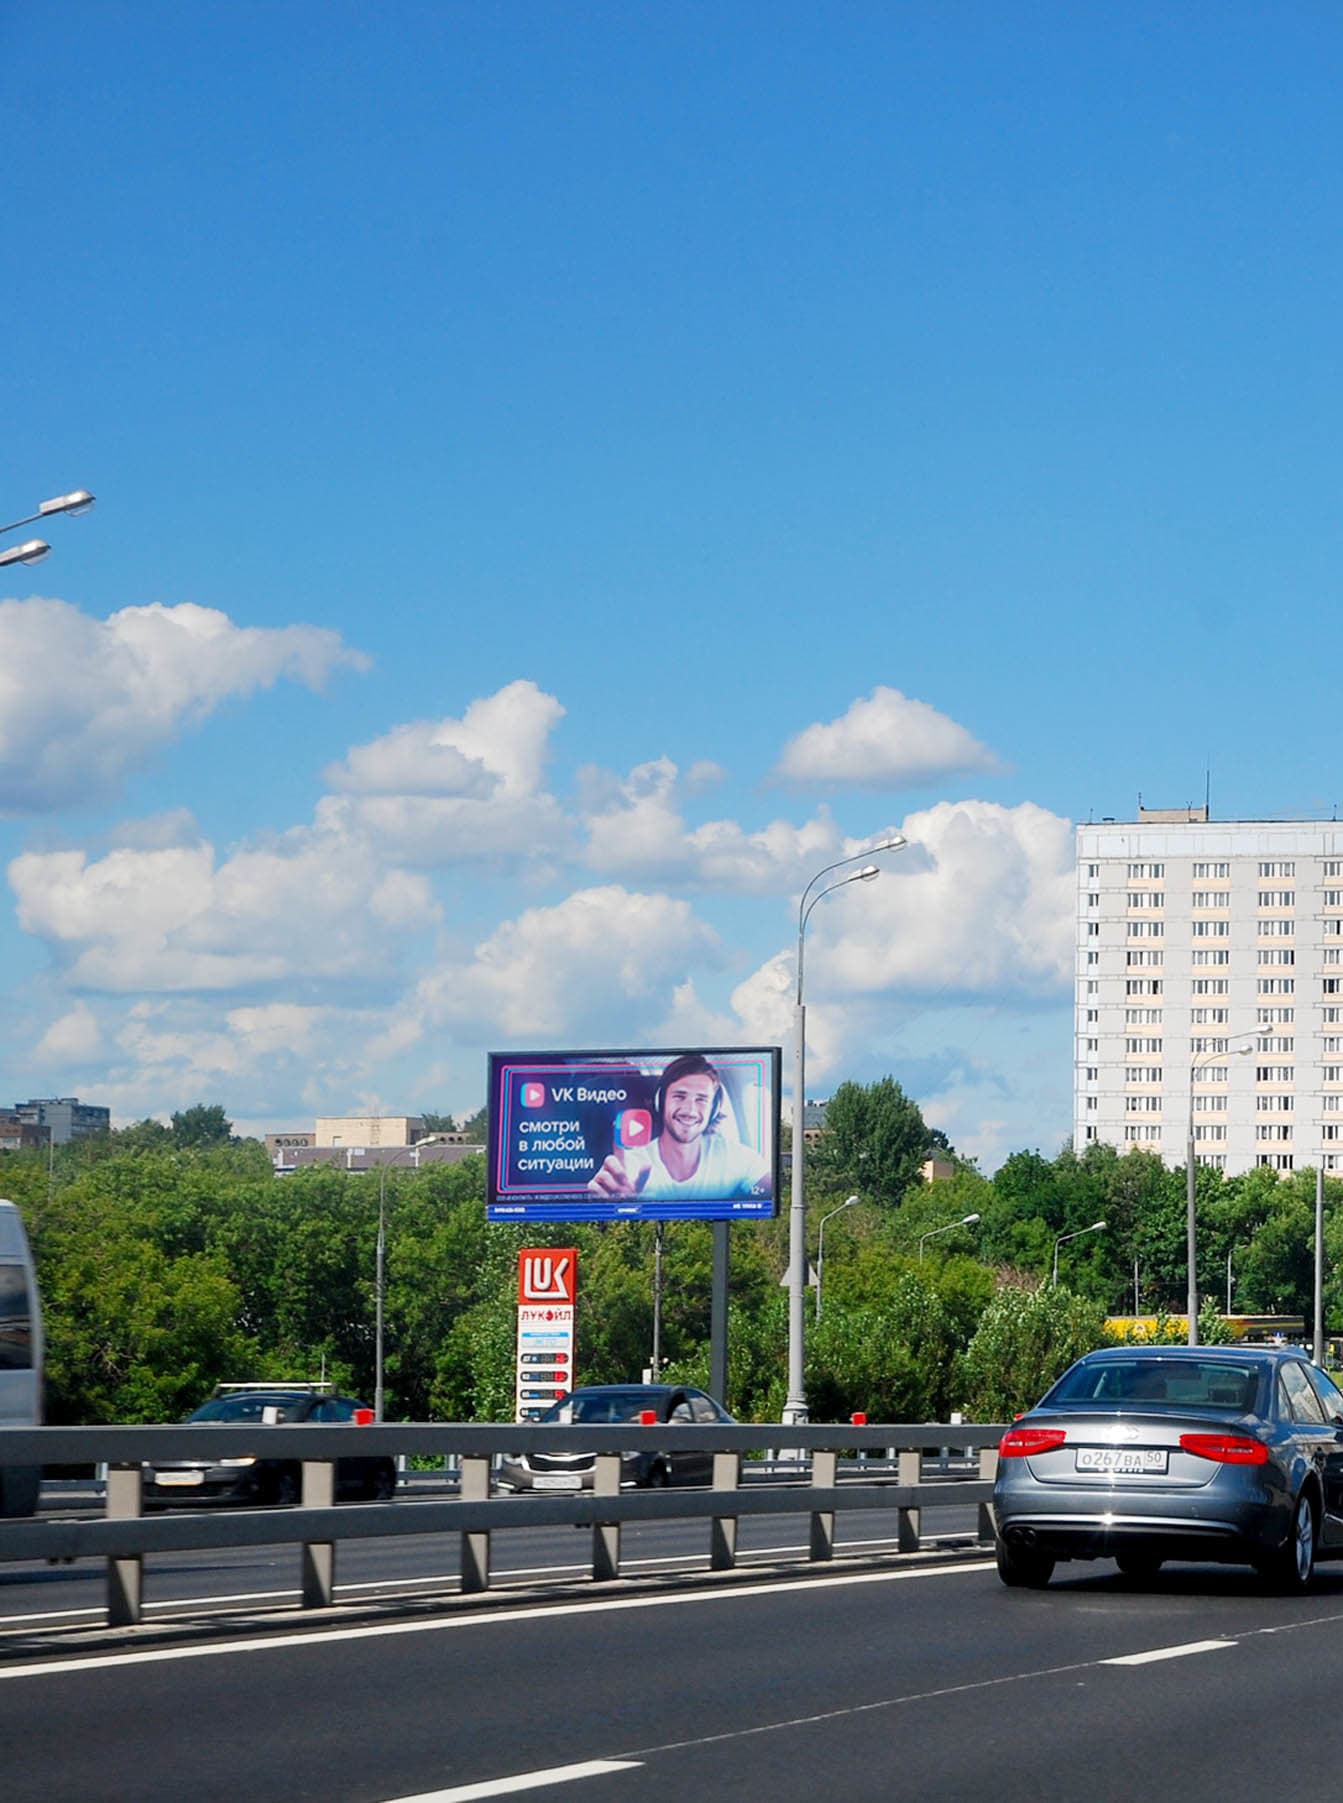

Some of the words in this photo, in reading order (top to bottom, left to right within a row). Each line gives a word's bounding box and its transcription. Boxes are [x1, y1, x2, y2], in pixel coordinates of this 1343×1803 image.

[551, 1088, 573, 1102] VK
[577, 1086, 627, 1103] Видео
[519, 1120, 580, 1137] смотри
[518, 1140, 528, 1152] в
[532, 1136, 585, 1152] любой
[518, 1157, 595, 1174] ситуации
